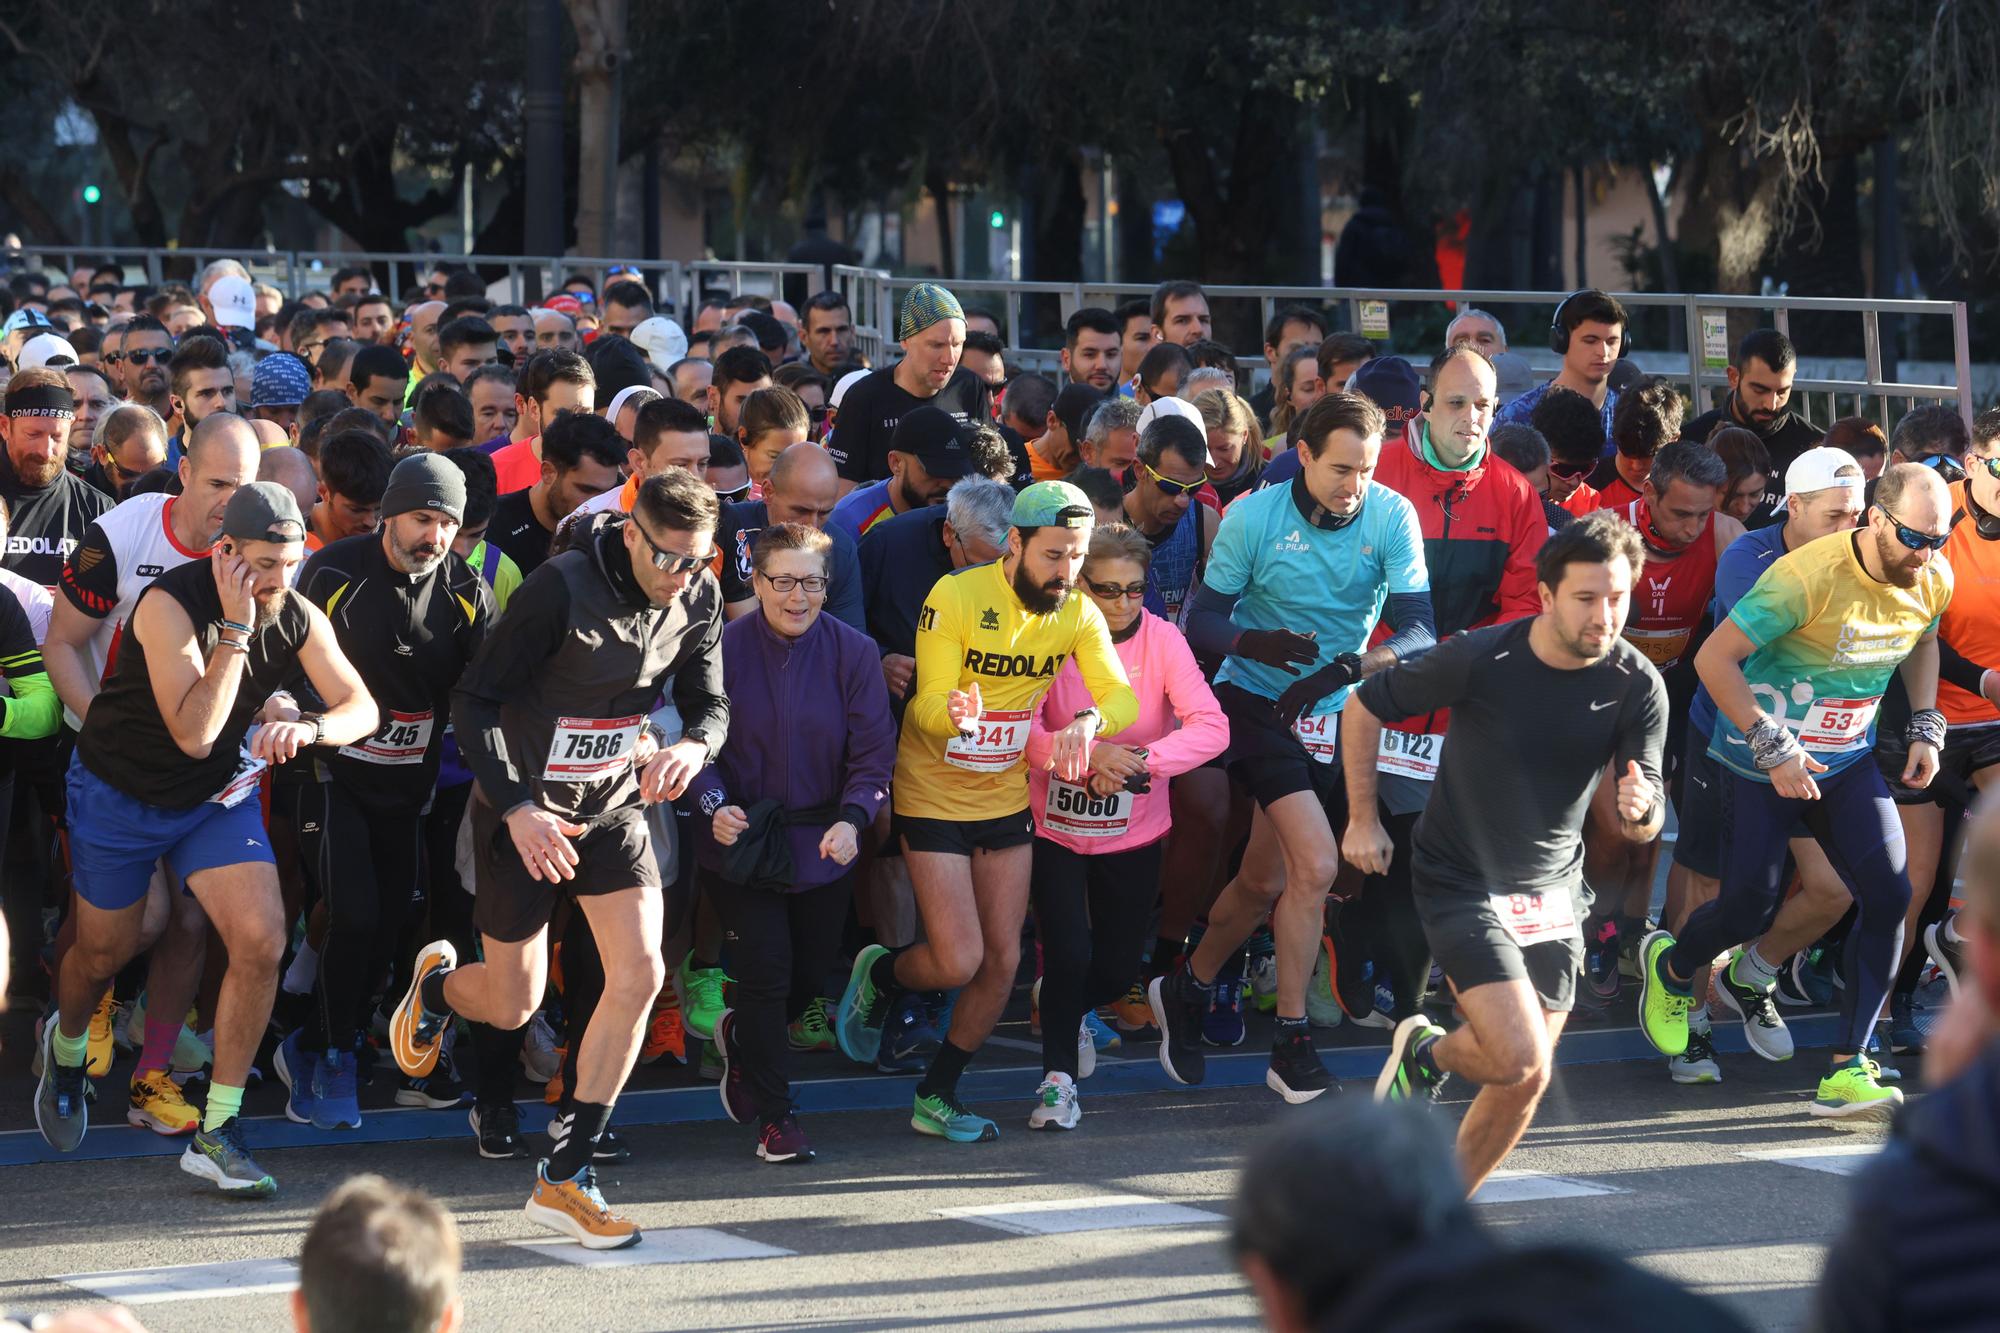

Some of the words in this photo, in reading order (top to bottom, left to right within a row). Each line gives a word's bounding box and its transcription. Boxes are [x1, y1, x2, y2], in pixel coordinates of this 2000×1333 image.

[6, 536, 79, 555] EDOLAT
[1820, 711, 1865, 731] 534
[563, 732, 624, 760] 7586
[1057, 786, 1120, 817] 5060
